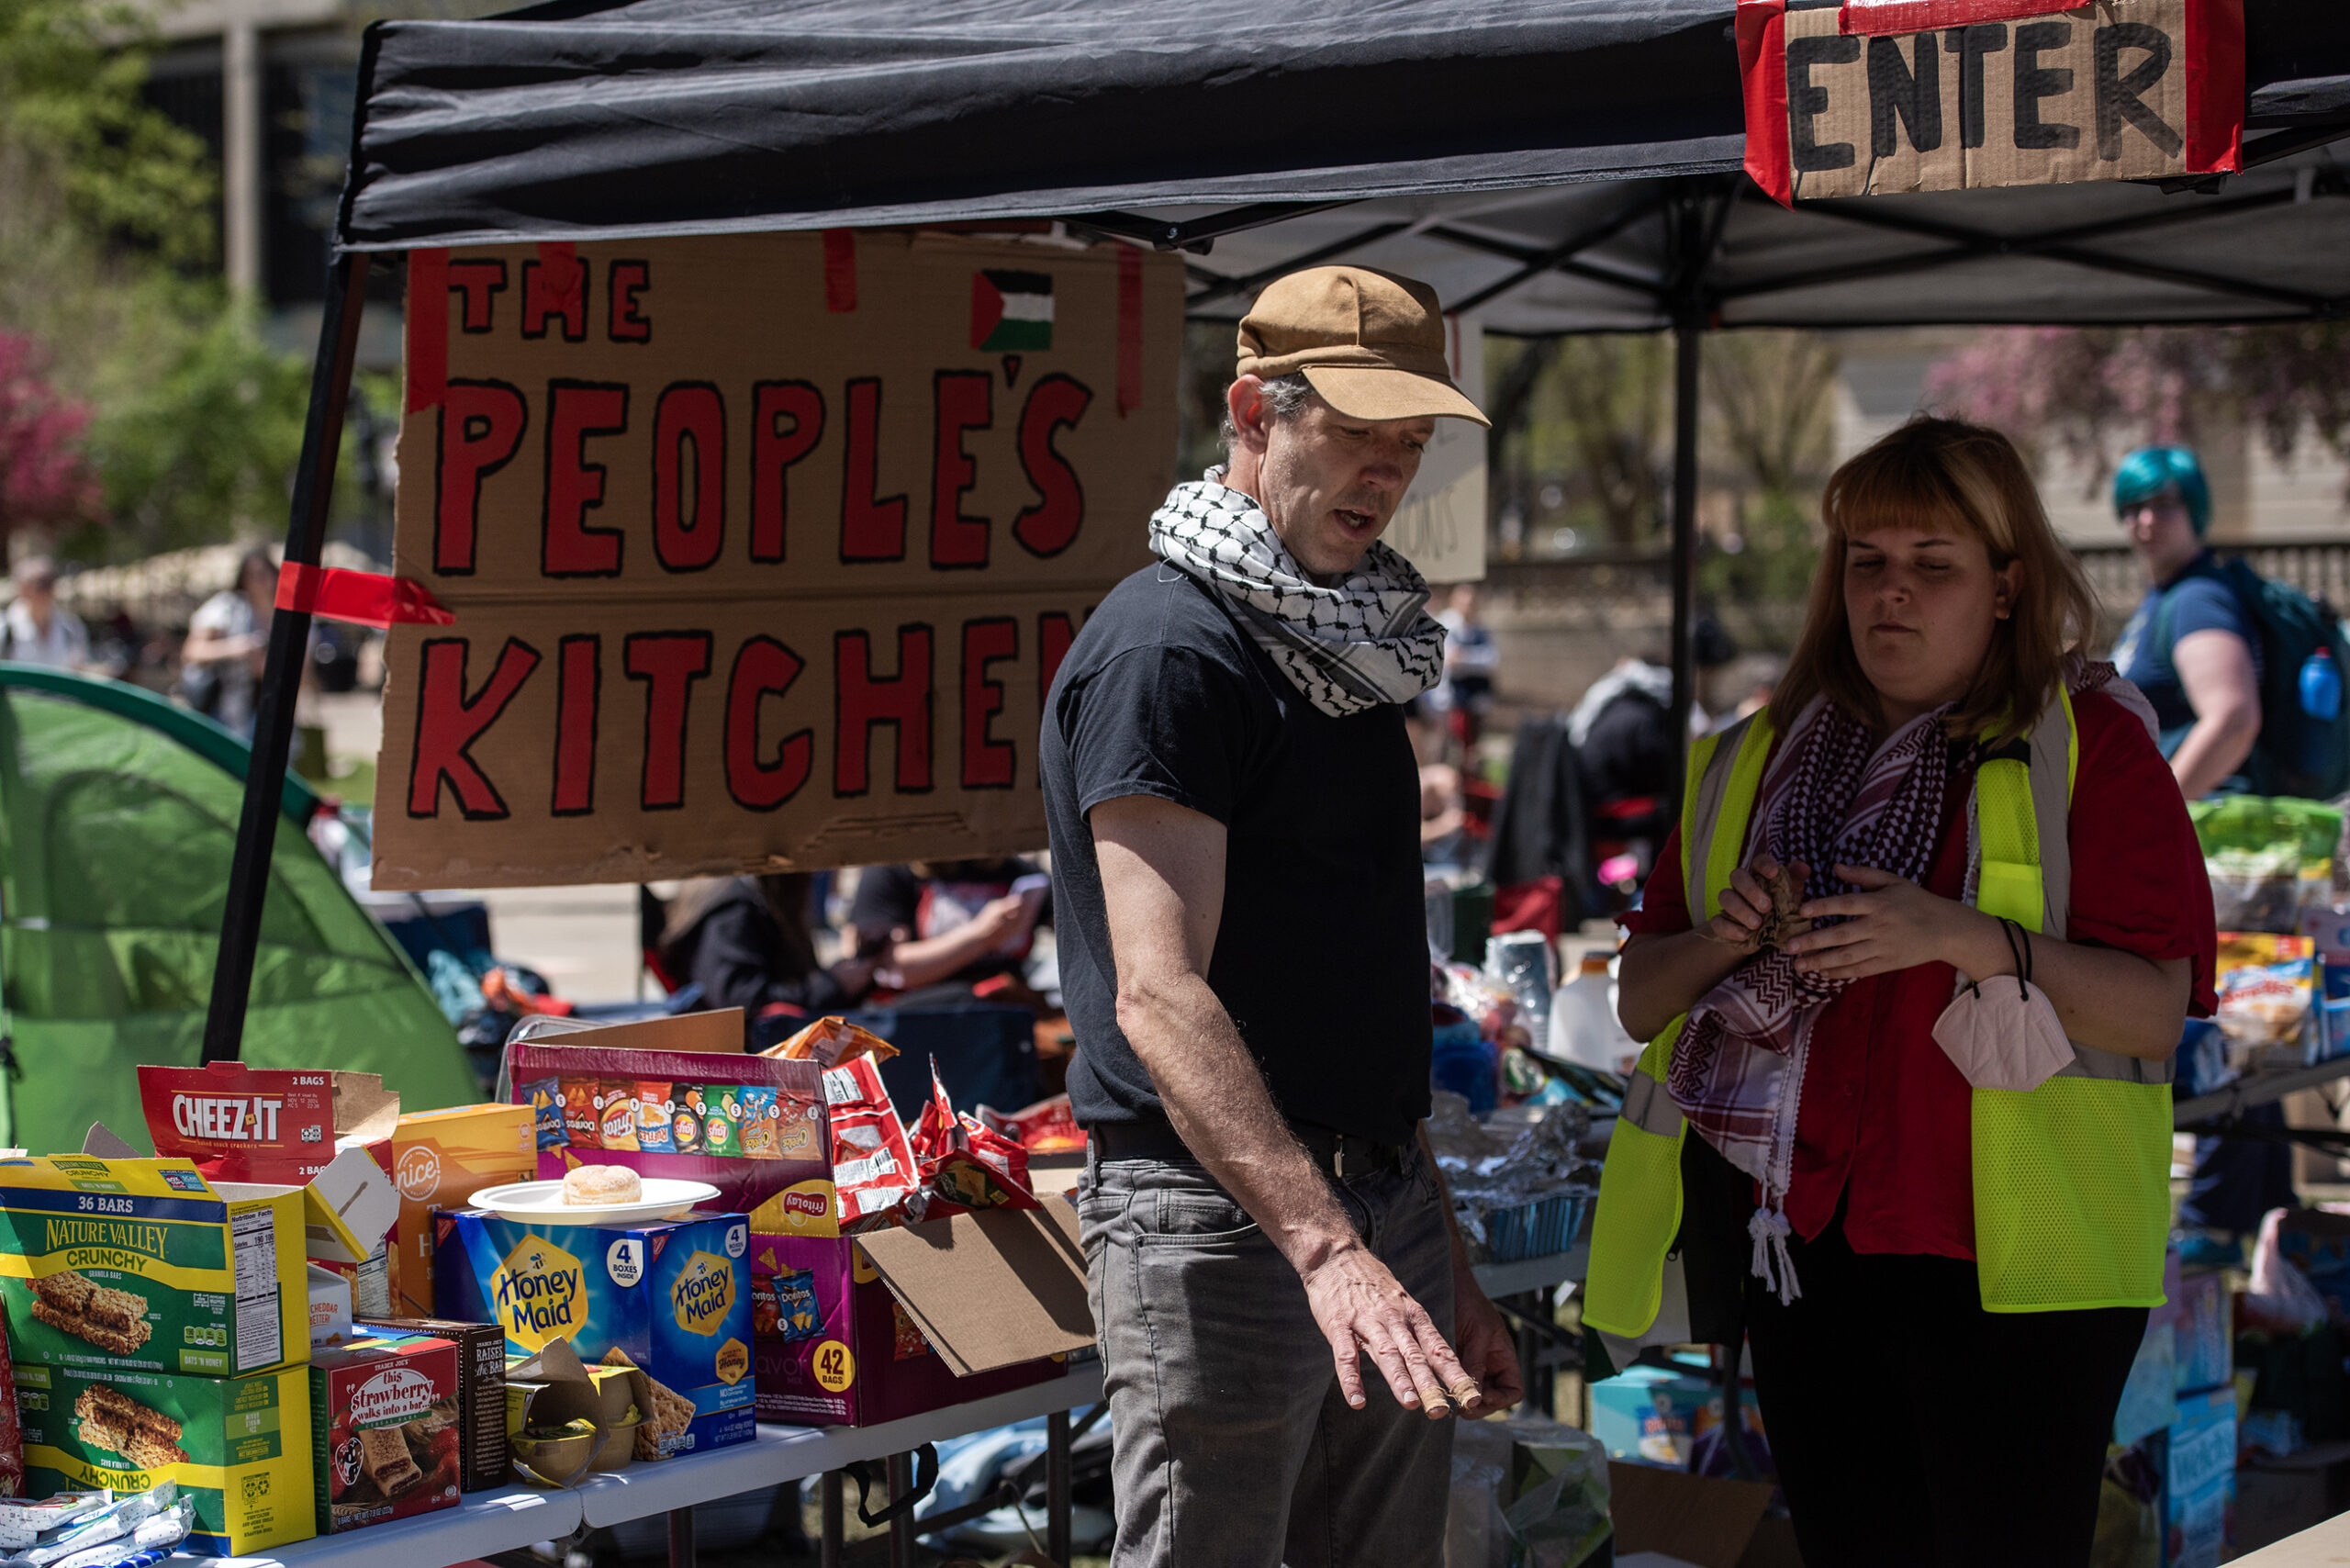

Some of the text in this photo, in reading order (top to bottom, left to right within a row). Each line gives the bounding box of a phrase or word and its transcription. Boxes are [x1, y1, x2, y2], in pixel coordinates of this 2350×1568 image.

[1786, 21, 2184, 172] ENTER
[448, 258, 652, 345] THE
[433, 356, 1094, 577] PEOPLE'S
[292, 1076, 324, 1085] 2 BAGS
[566, 1120, 596, 1132] Doritos
[603, 1111, 634, 1137] Fritos
[676, 1122, 694, 1136] Lay's
[708, 1125, 726, 1137] Lay's
[66, 1170, 109, 1178] CRUNCHY
[298, 1166, 326, 1175] 2 BA
[397, 1154, 441, 1192] nice!
[78, 1196, 133, 1213] 36 BARS
[231, 1214, 256, 1223] Nutrition
[46, 1218, 169, 1260] NATURE VALLEY
[731, 1229, 740, 1242] 4
[67, 1249, 148, 1271] CRUNCHY
[616, 1244, 631, 1264] 4
[89, 1270, 122, 1280] GRANOLA BARS
[613, 1264, 638, 1273] BOXES
[497, 1268, 577, 1307] Honey
[676, 1266, 729, 1307] Honey
[752, 1292, 776, 1302] oritos
[781, 1290, 811, 1303] Doritos
[310, 1302, 338, 1314] CHEDDAR
[686, 1286, 726, 1324] Maid
[512, 1294, 573, 1334] Maid
[476, 1345, 503, 1361] RAISES
[185, 1356, 197, 1365] OATS
[206, 1358, 222, 1367] HONEY
[489, 1360, 504, 1374] BAR
[718, 1358, 744, 1370] Honey
[755, 1356, 807, 1375] avor
[821, 1349, 844, 1375] 42
[383, 1371, 402, 1384] this
[822, 1375, 844, 1384] BAGS
[357, 1407, 380, 1421] walks
[383, 1404, 400, 1416] into
[402, 1405, 408, 1413] a
[79, 1466, 151, 1490] CRUNCHY
[341, 1515, 352, 1525] BARS
